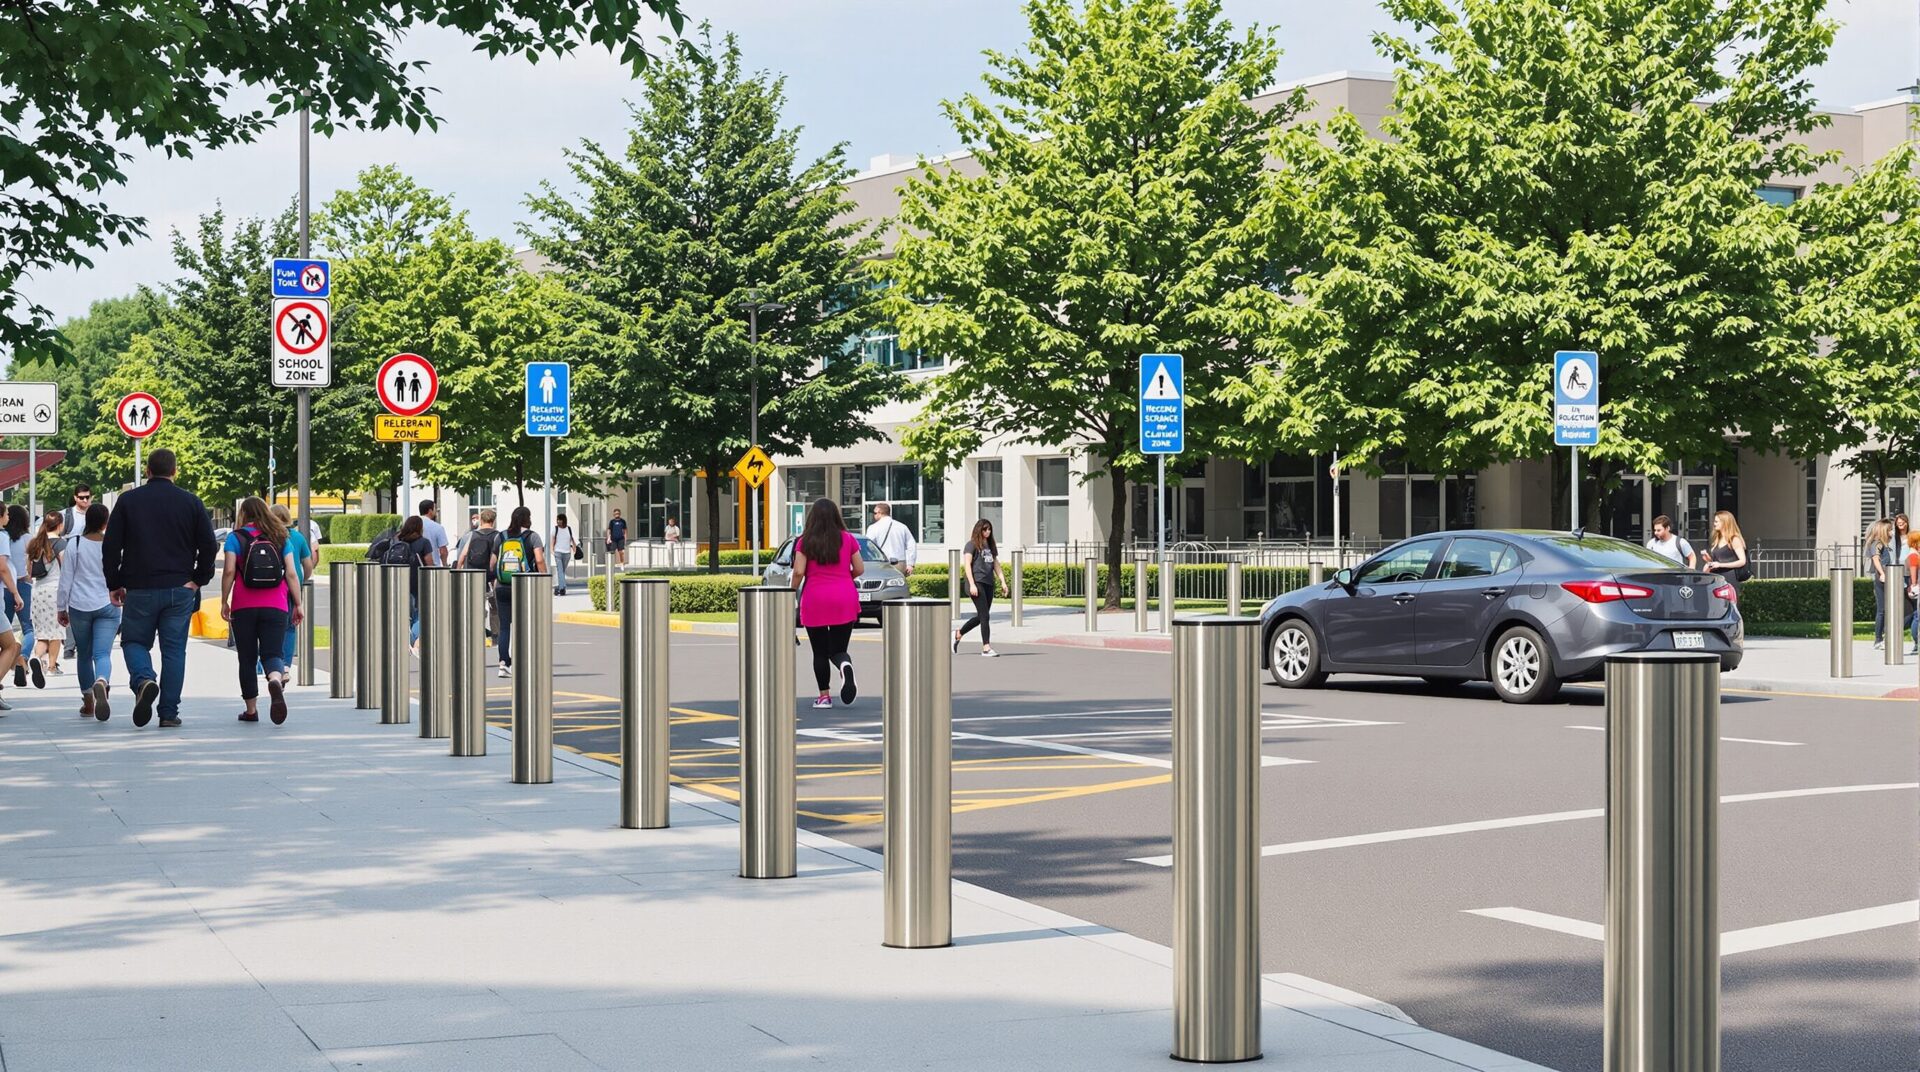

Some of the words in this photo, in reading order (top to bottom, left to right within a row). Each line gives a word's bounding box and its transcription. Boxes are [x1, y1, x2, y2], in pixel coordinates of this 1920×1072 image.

[278, 358, 324, 369] SCHOOL
[285, 370, 316, 381] ZONE
[393, 429, 420, 439] ZONE
